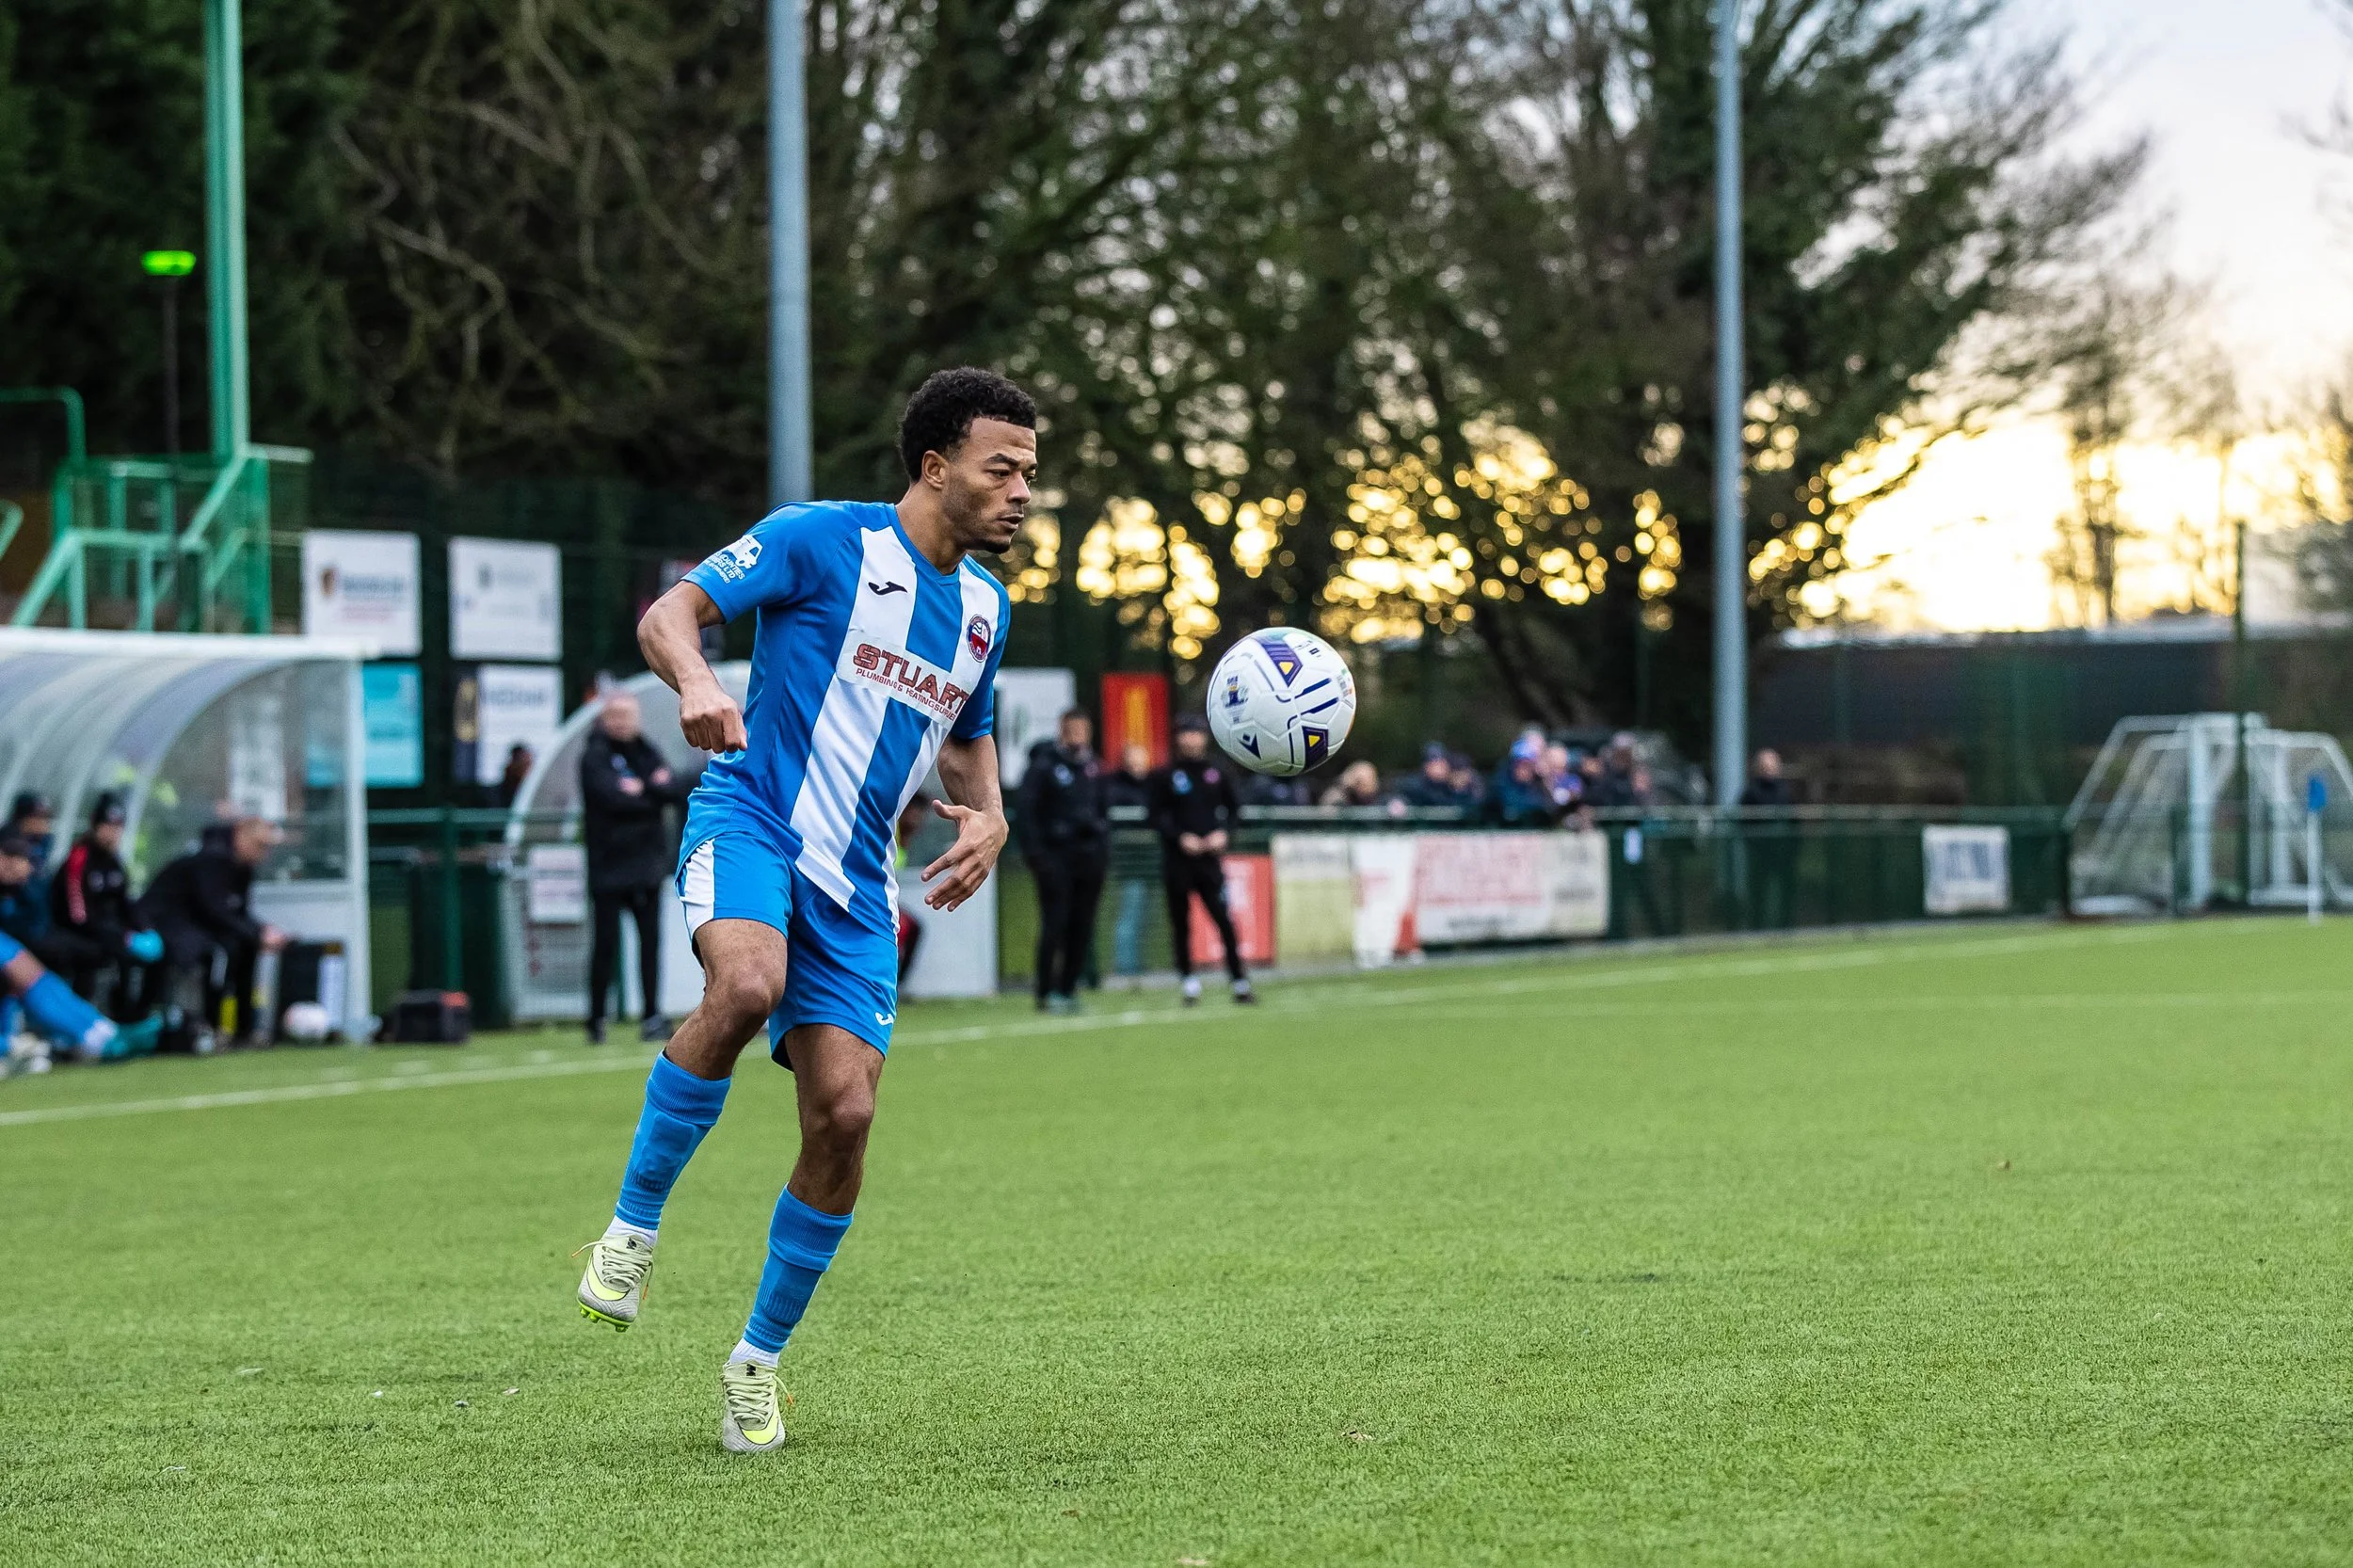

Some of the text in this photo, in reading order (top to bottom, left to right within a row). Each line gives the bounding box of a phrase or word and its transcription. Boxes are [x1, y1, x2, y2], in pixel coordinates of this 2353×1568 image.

[724, 567, 736, 579] LTD
[853, 643, 969, 714] STUART
[856, 667, 898, 689] PLUMBING
[905, 687, 935, 708] HEATING
